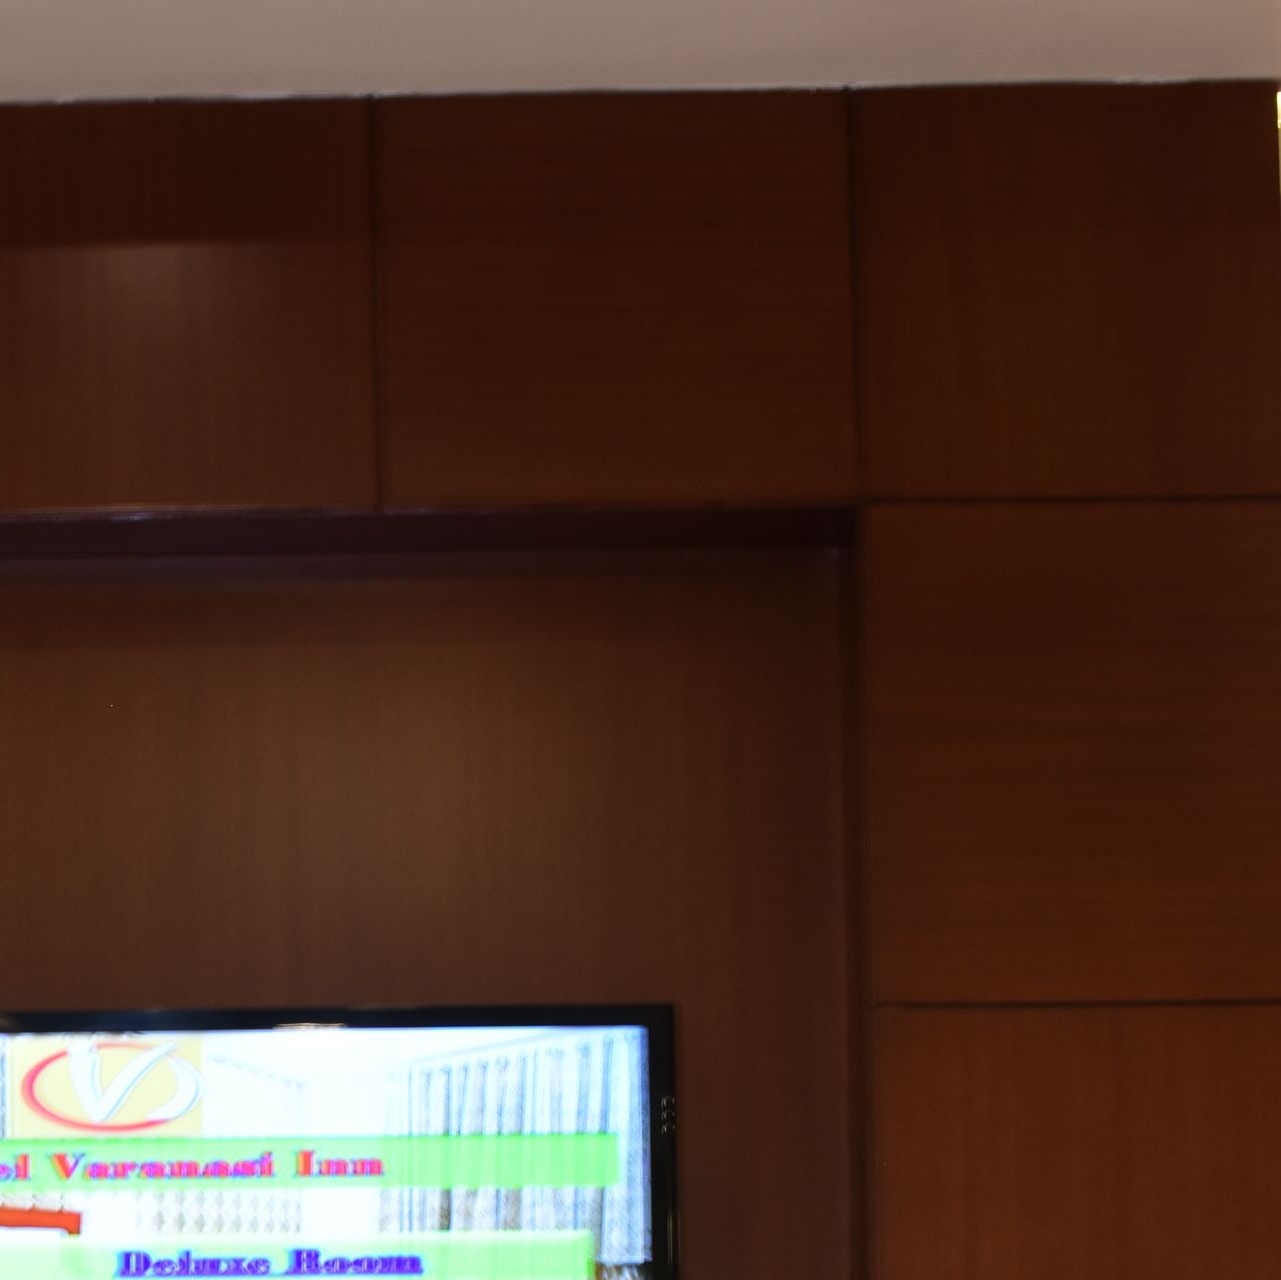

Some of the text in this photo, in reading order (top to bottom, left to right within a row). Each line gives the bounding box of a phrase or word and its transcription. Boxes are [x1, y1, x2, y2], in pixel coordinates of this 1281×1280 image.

[49, 1151, 275, 1181] Varanasi
[293, 1149, 385, 1178] Inn
[115, 1248, 424, 1278] Deluxe Room
